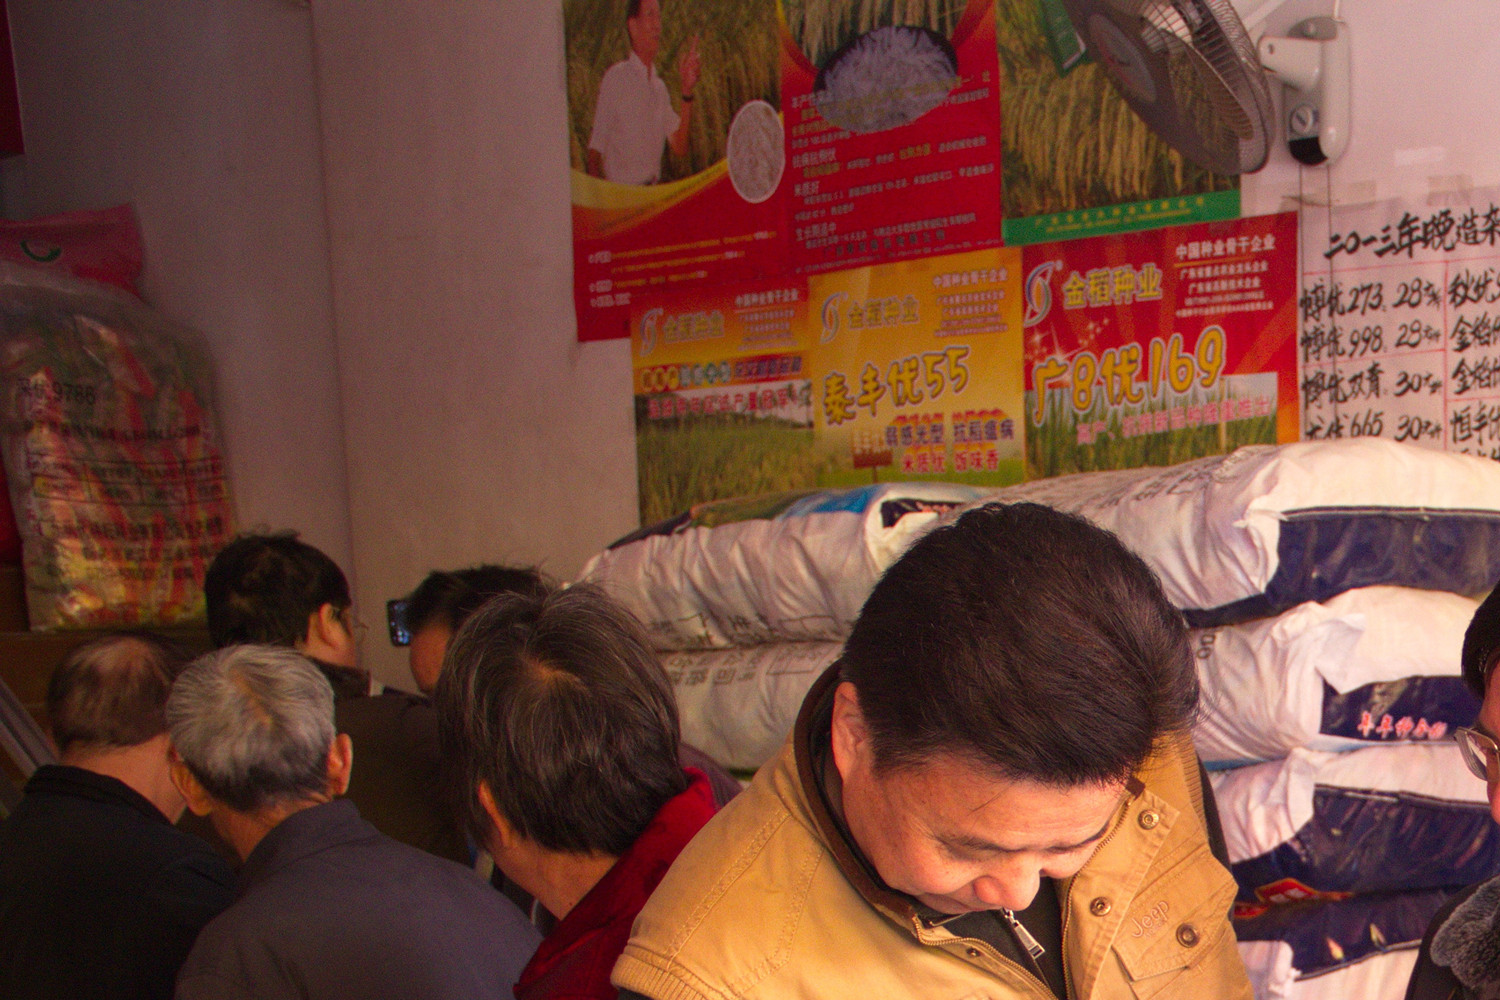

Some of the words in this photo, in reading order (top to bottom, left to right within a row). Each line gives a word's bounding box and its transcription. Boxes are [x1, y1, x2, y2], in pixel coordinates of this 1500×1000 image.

[1063, 262, 1163, 310] 金稻种业
[822, 344, 971, 426] 泰丰优55
[1033, 325, 1227, 428] 广8优169
[1131, 900, 1169, 938] Jeep
